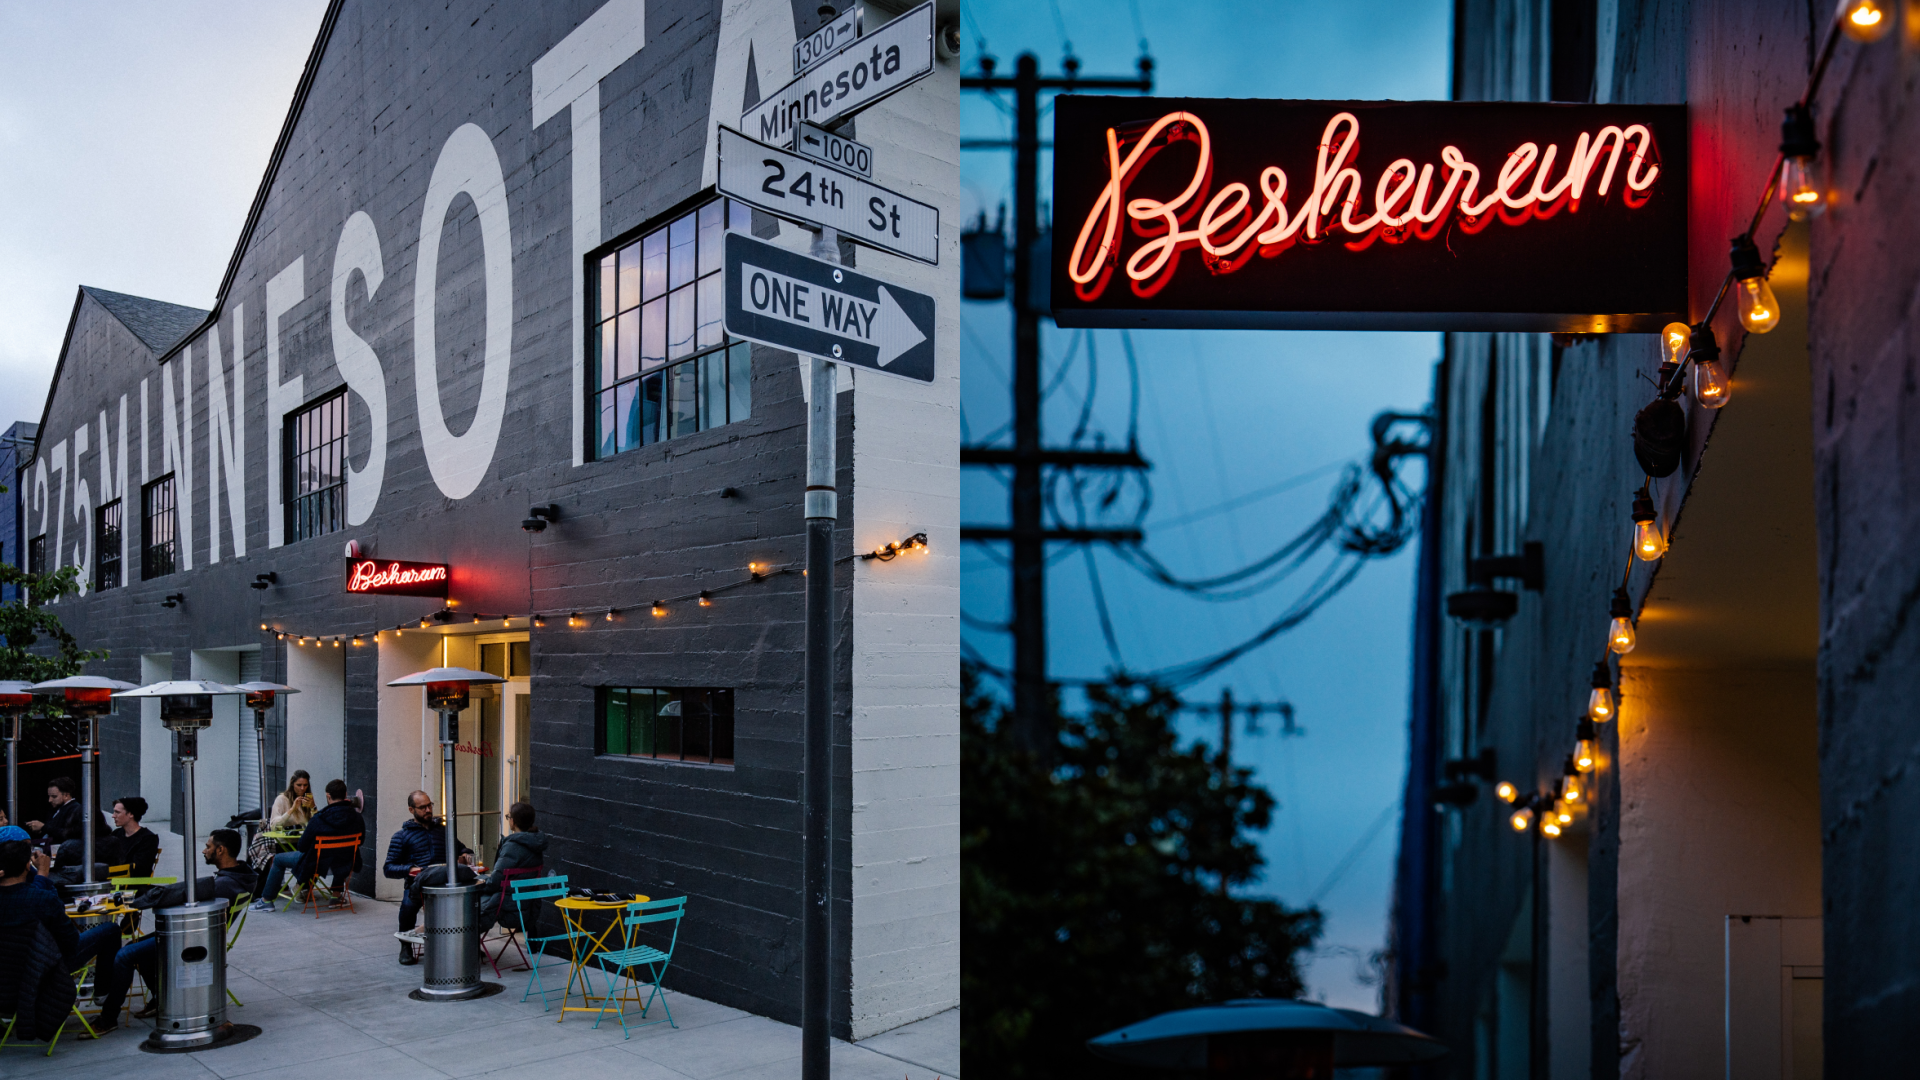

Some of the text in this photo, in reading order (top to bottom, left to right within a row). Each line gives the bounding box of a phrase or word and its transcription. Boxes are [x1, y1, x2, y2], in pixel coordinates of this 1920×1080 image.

[797, 26, 835, 69] 1300
[761, 44, 900, 141] Minnesota
[824, 135, 868, 172] 1000
[762, 159, 901, 239] 24th St
[1068, 111, 1660, 290] Besharam
[751, 272, 878, 340] ONE WAY
[21, 423, 92, 609] 1275
[350, 561, 447, 591] Besharam
